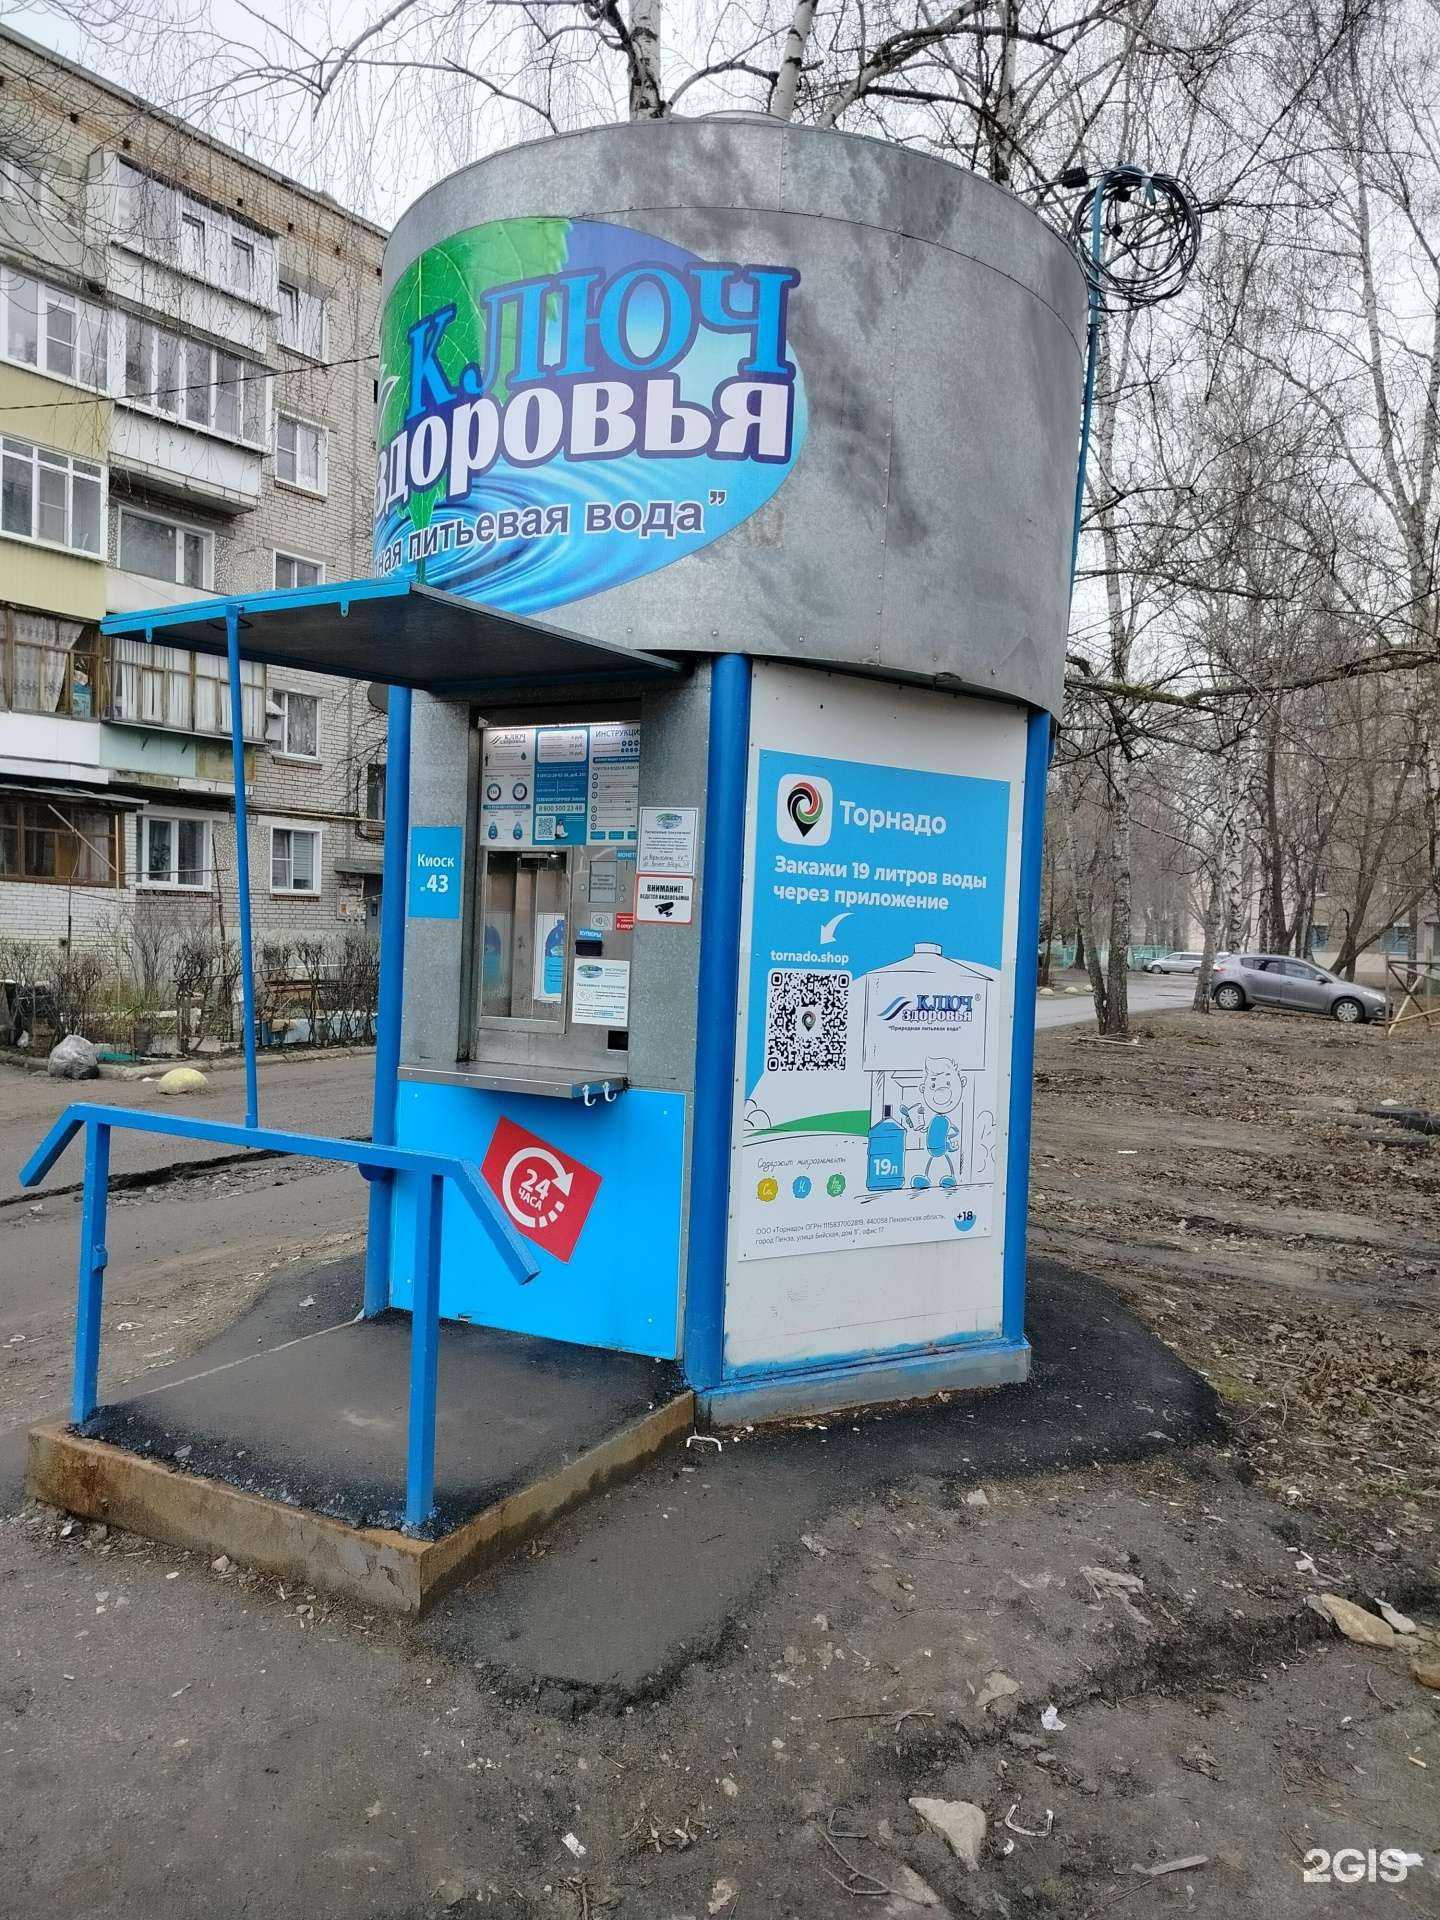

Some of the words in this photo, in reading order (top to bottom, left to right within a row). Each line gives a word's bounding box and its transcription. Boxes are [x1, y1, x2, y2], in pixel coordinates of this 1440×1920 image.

[407, 264, 798, 419] КЛЮЧ
[408, 503, 569, 562] питьевая
[839, 800, 947, 837] Торнадо
[417, 853, 455, 868] Киоск
[774, 855, 847, 878] Закажи
[852, 861, 869, 880] 19
[874, 866, 938, 888] литров
[942, 873, 987, 890] воды
[647, 884, 684, 893] ВНИМАНИЕ!
[773, 885, 829, 906] через
[835, 888, 949, 911] приложение
[770, 950, 849, 966] tornado.shop
[521, 1168, 551, 1200] 24
[518, 1186, 543, 1211] ЧАСА
[957, 1210, 973, 1221] +18
